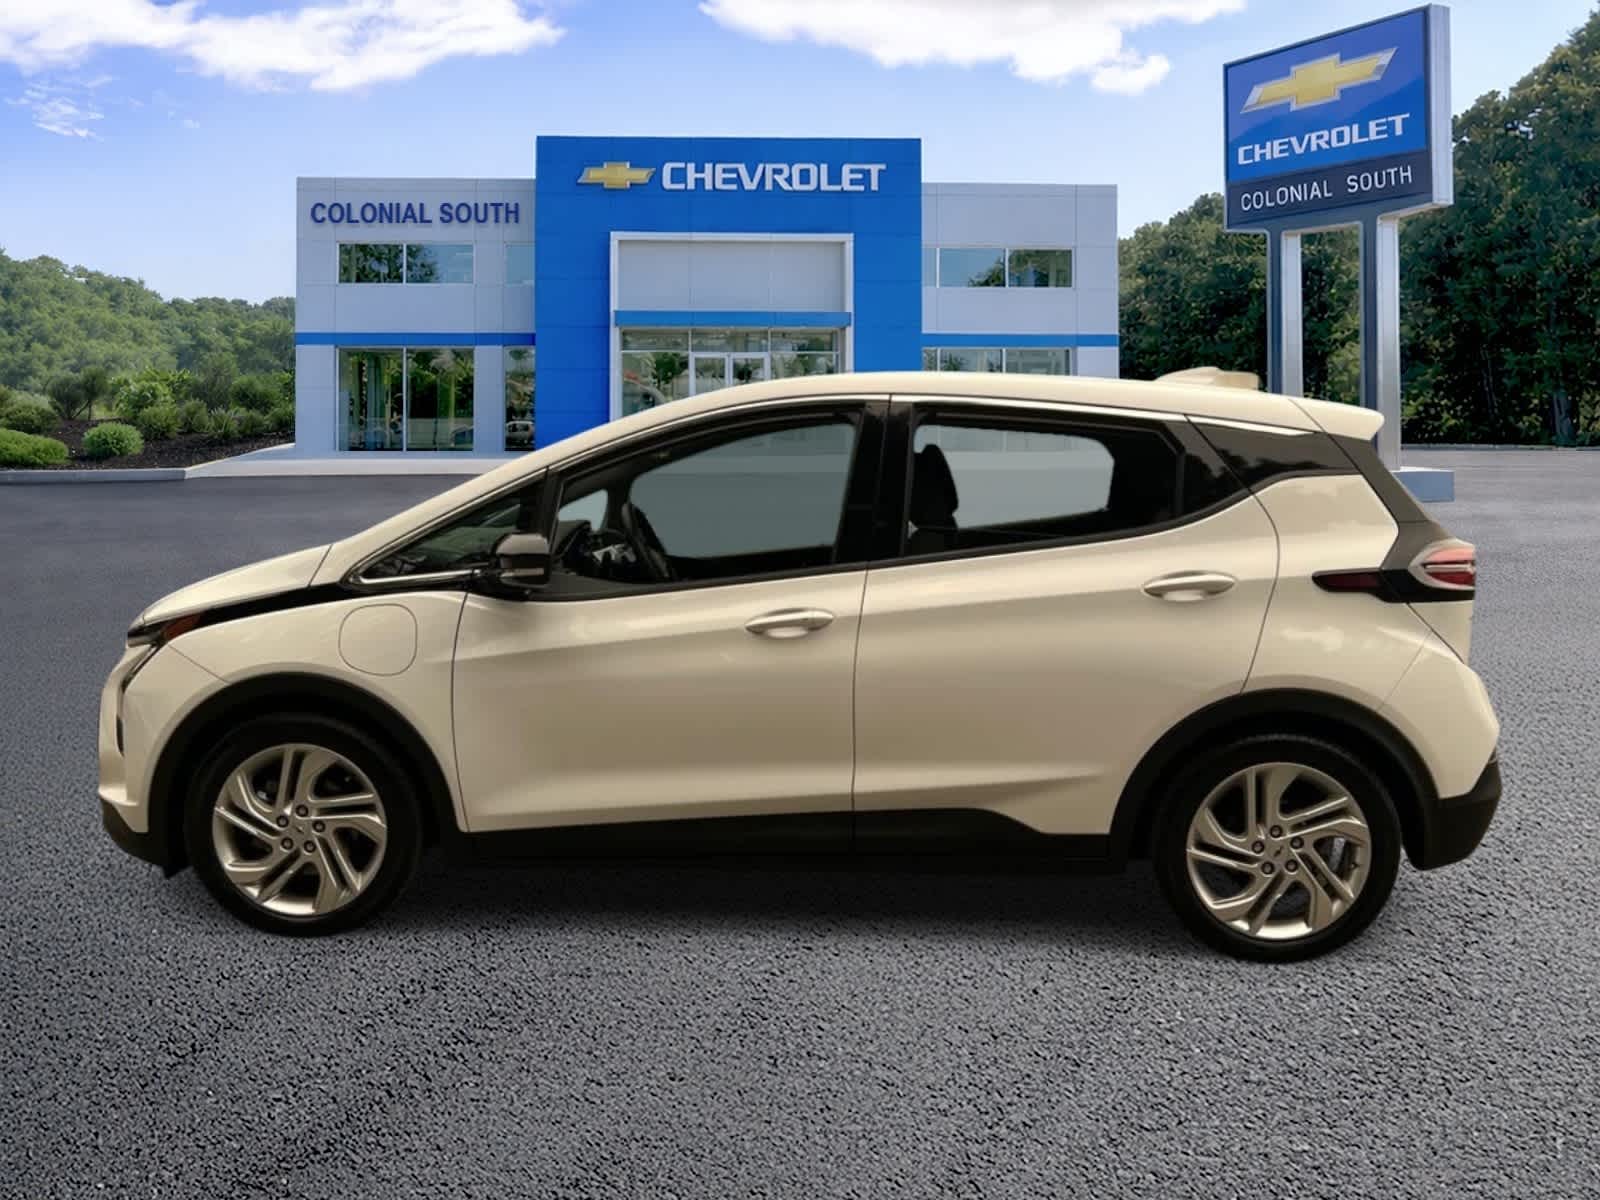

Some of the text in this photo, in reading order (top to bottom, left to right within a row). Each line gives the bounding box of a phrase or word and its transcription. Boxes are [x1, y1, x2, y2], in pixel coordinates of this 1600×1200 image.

[1237, 112, 1410, 166] CHEVROLET
[661, 161, 887, 193] CHEVROLET
[1240, 164, 1413, 212] COLONIAL SOUTH
[310, 202, 521, 225] COLONIAL SOUTH
